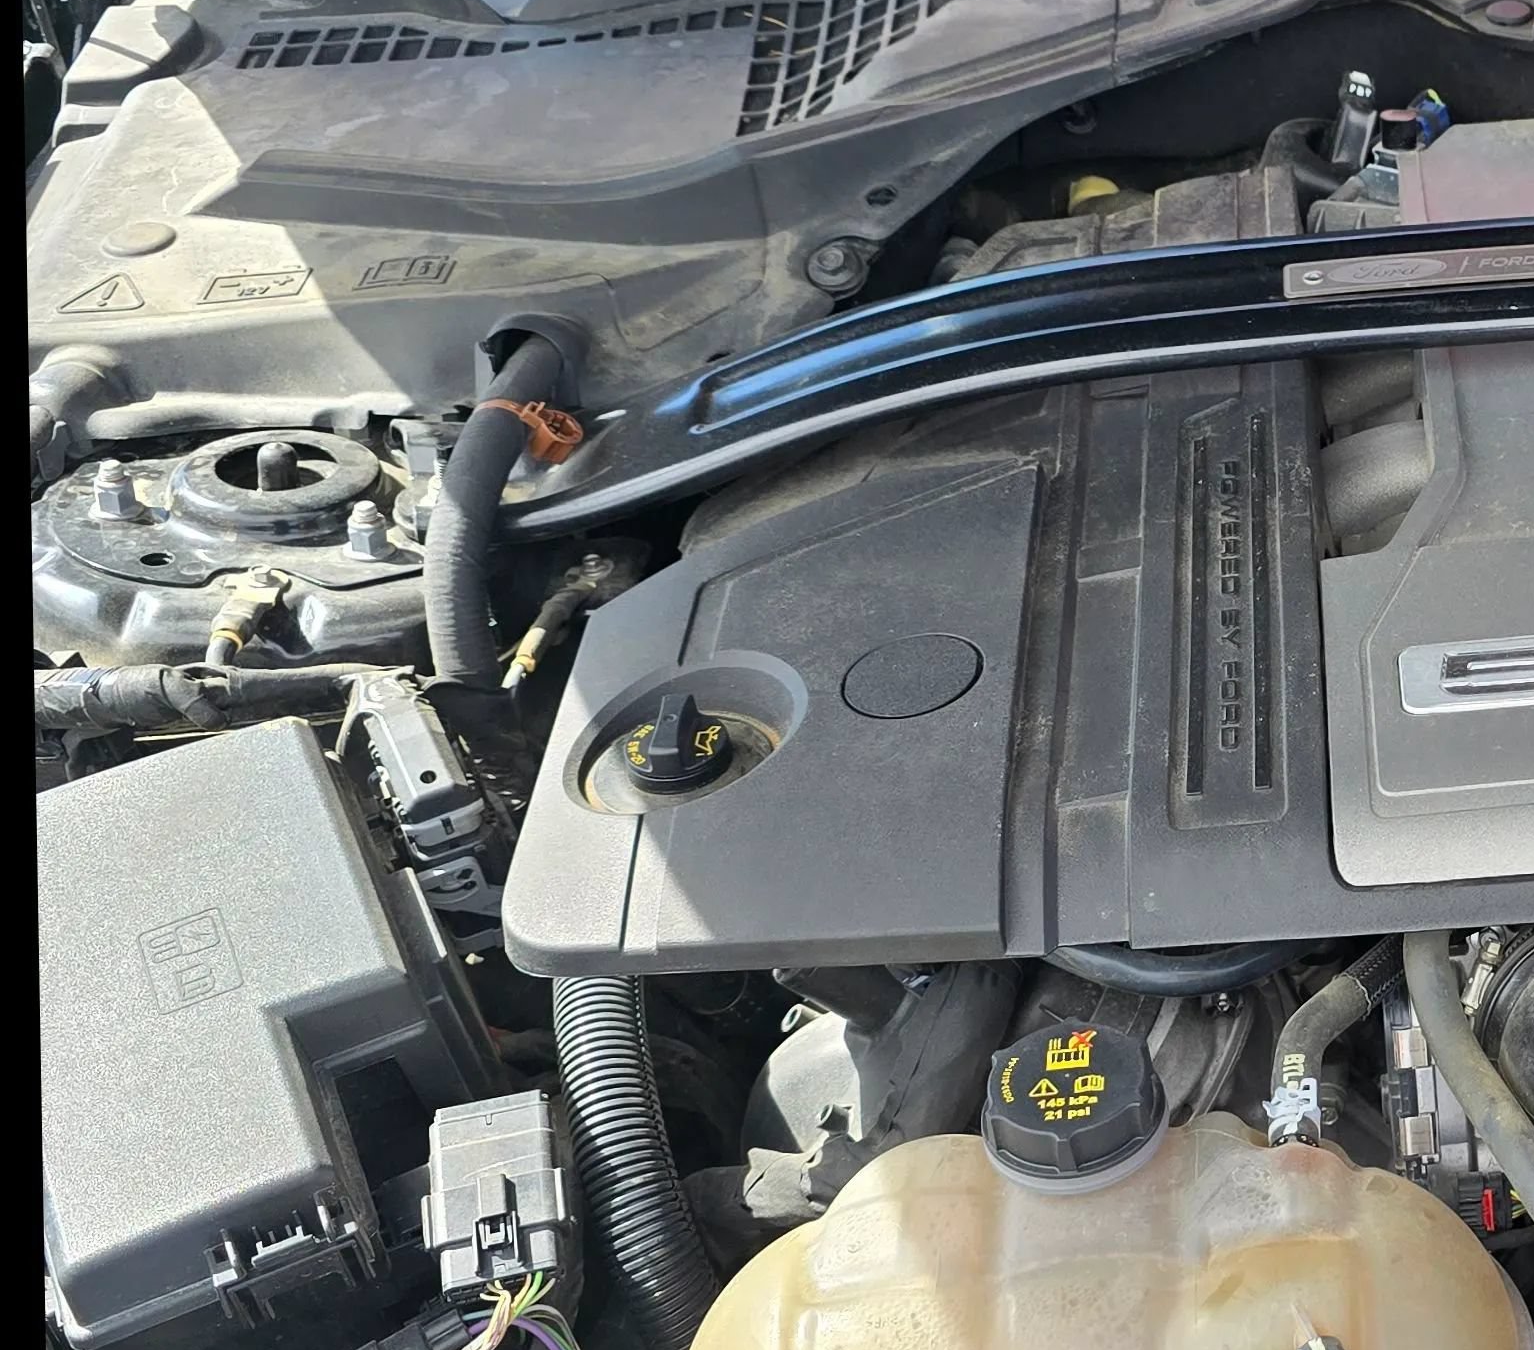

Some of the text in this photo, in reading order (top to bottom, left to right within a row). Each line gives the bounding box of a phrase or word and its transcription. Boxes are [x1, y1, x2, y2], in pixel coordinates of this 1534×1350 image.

[1352, 263, 1422, 280] Ford
[1218, 459, 1242, 751] POWERED BY FORD
[1036, 1095, 1099, 1110] 145 kPa
[1043, 1106, 1091, 1122] 21 psi
